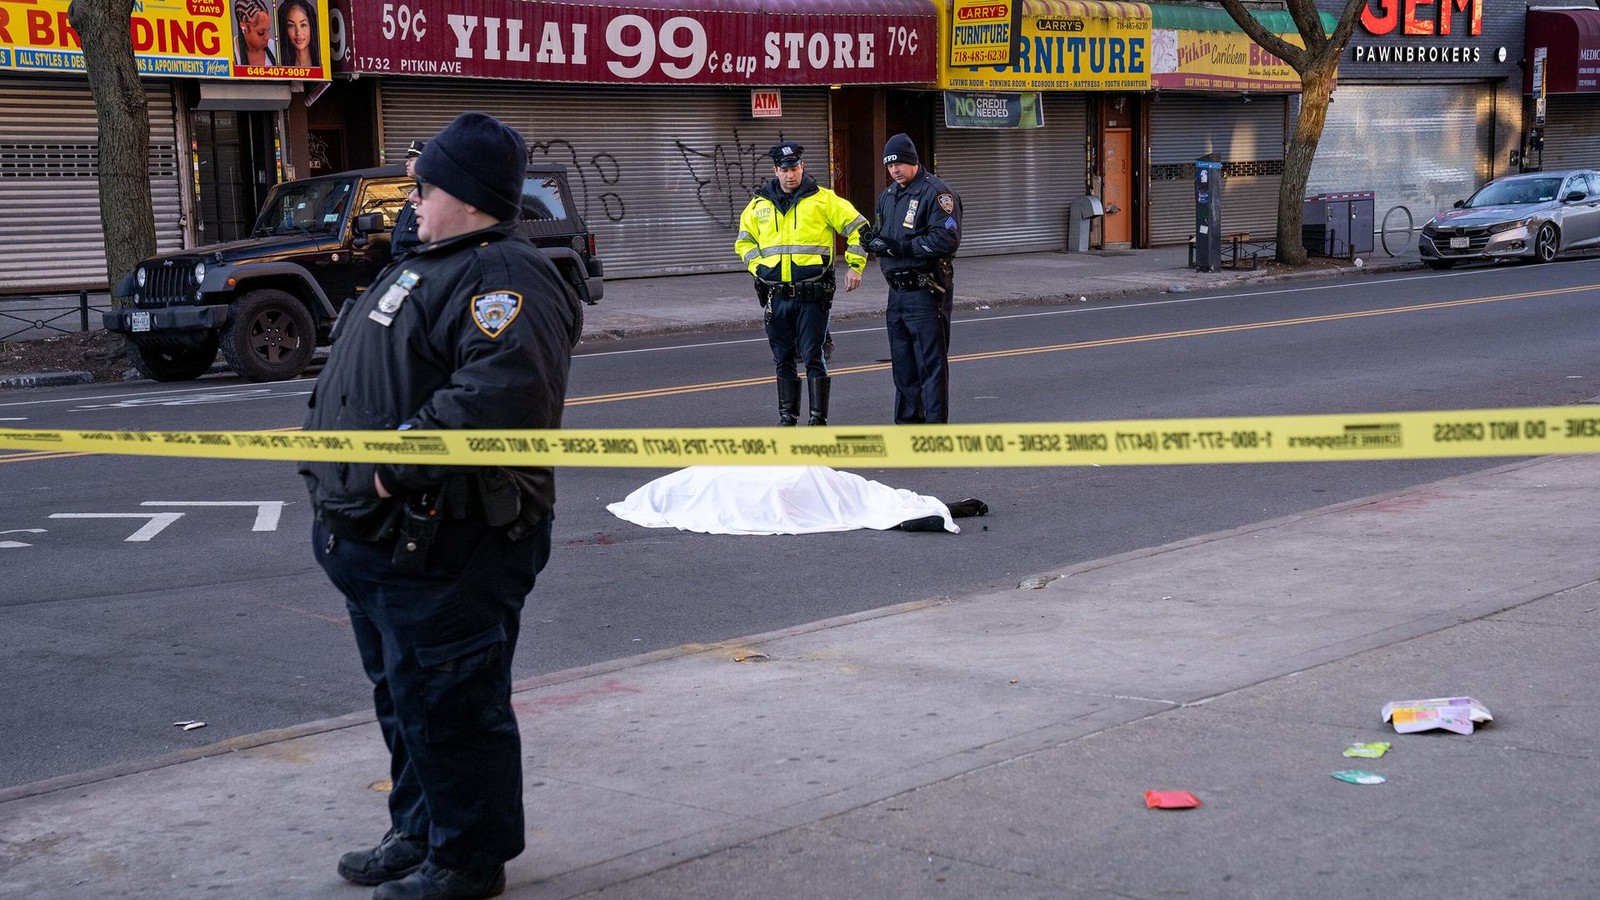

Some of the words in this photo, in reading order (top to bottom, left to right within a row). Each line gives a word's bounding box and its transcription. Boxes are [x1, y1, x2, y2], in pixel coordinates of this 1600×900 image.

[199, 6, 221, 14] DAYS
[959, 6, 1005, 20] LARRY'S
[1361, 0, 1482, 35] GEM
[381, 3, 427, 42] 59¢
[1038, 20, 1083, 31] LARRY'S
[26, 9, 221, 56] BRDING
[887, 26, 919, 56] 79¢
[954, 23, 1009, 46] FURNITURE
[447, 14, 588, 65] YILAI
[764, 31, 875, 70] STORE
[20, 52, 34, 65] ALL
[35, 53, 63, 68] STYLES
[954, 50, 1008, 63] 718-485-6230
[969, 35, 1145, 74] RNITURE
[1177, 40, 1211, 66] Pitkin
[1211, 44, 1248, 66] Caribbean
[1356, 46, 1481, 63] PAWNBROKERS
[154, 59, 204, 73] APPOINTMENTS
[247, 66, 311, 77] 646-407-9087
[359, 57, 390, 70] 1732
[400, 60, 437, 72] PITKIN
[440, 62, 462, 74] AVE
[949, 79, 969, 87] LIVING
[970, 79, 985, 87] ROOM
[1055, 80, 1069, 88] SETS
[1073, 80, 1100, 88] MATTRESS
[754, 93, 779, 109] ATM
[954, 97, 977, 117] NO
[976, 98, 1008, 109] CREDIT
[976, 108, 1009, 118] NEEDED
